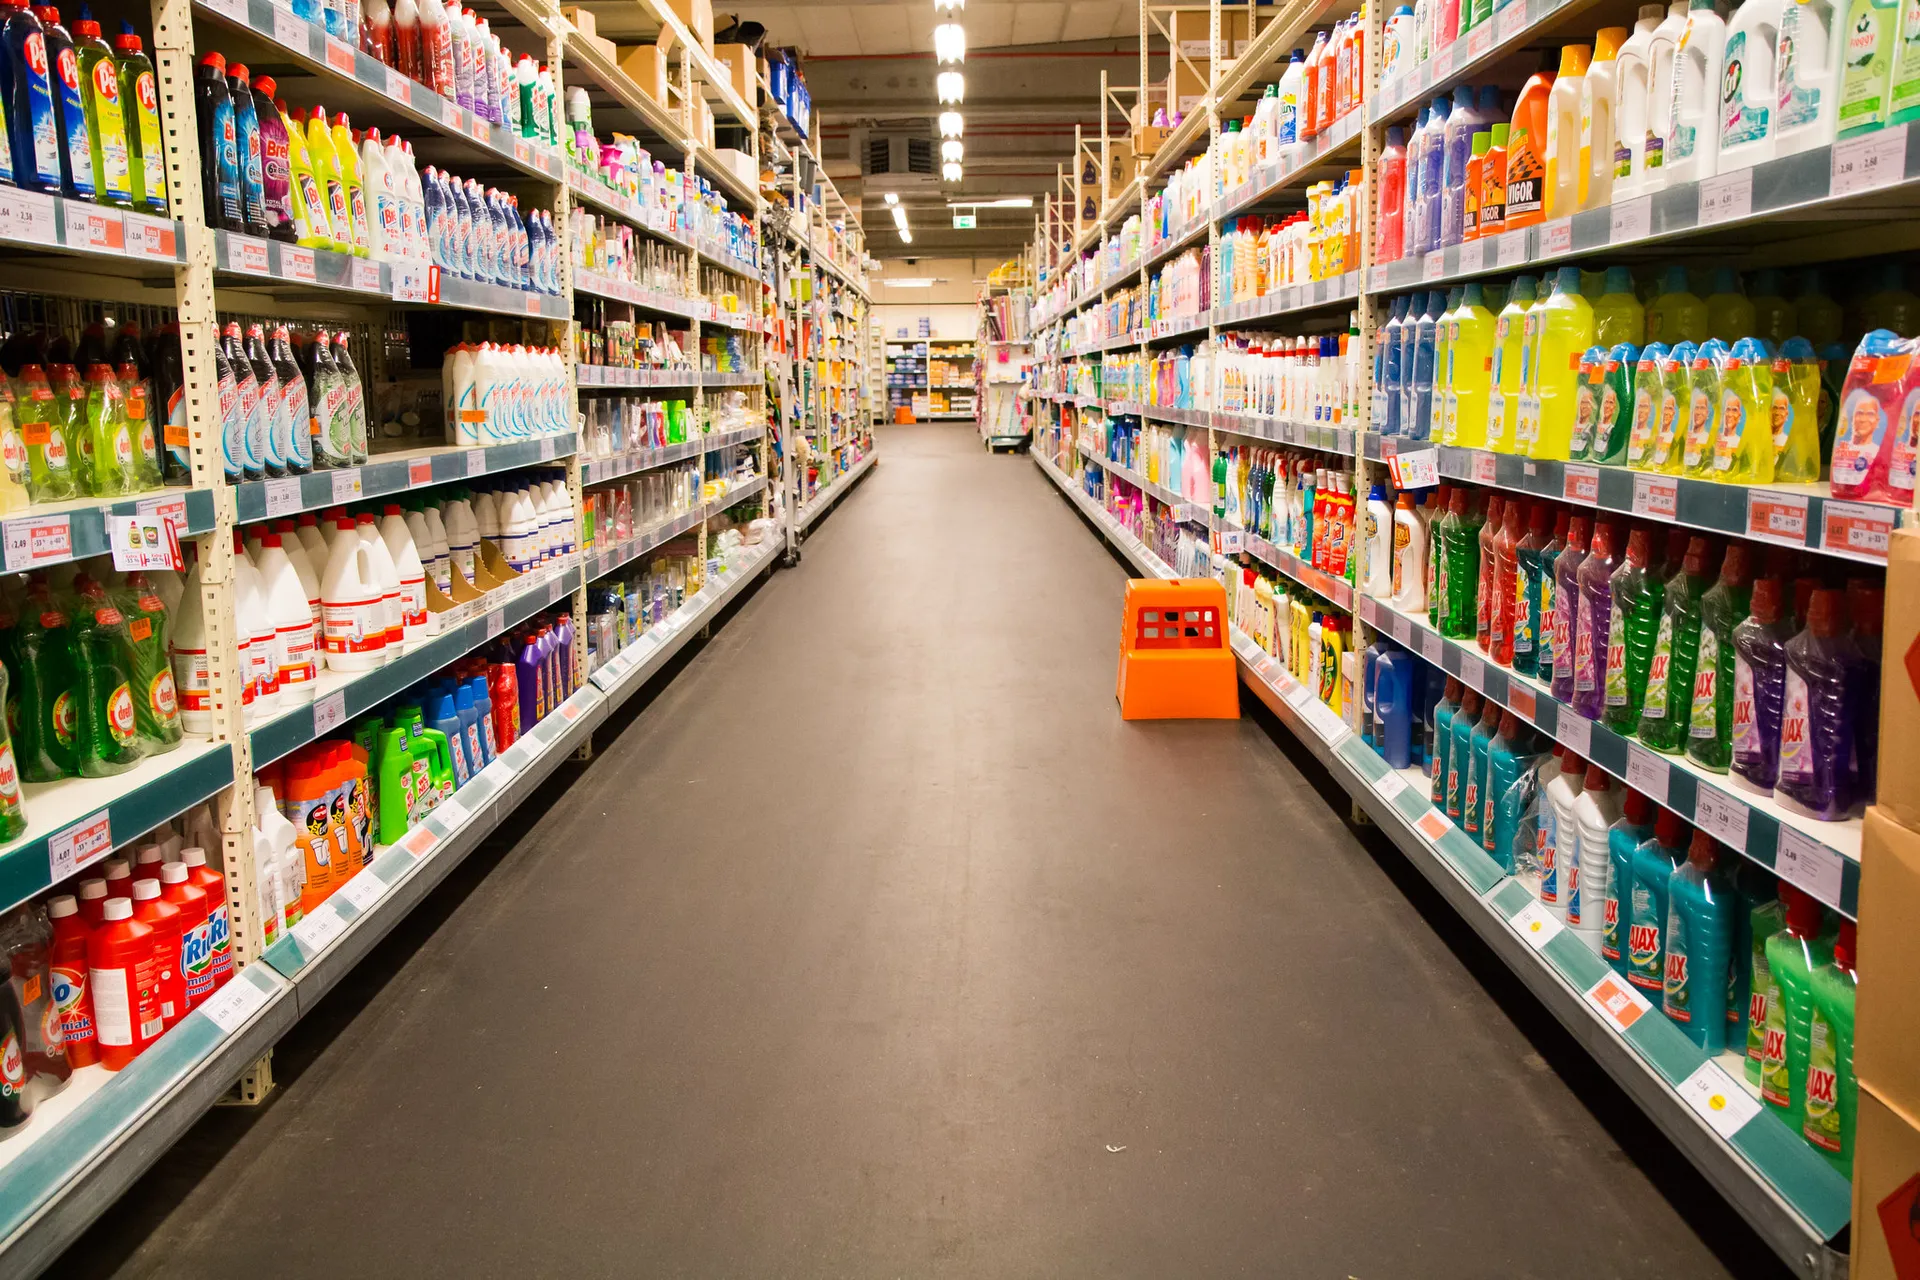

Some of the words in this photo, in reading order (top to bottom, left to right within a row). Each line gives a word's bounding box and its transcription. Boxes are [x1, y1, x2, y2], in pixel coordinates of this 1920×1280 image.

[1508, 181, 1534, 204] VIGOR
[315, 226, 321, 235] 4
[1629, 925, 1659, 953] AJAX
